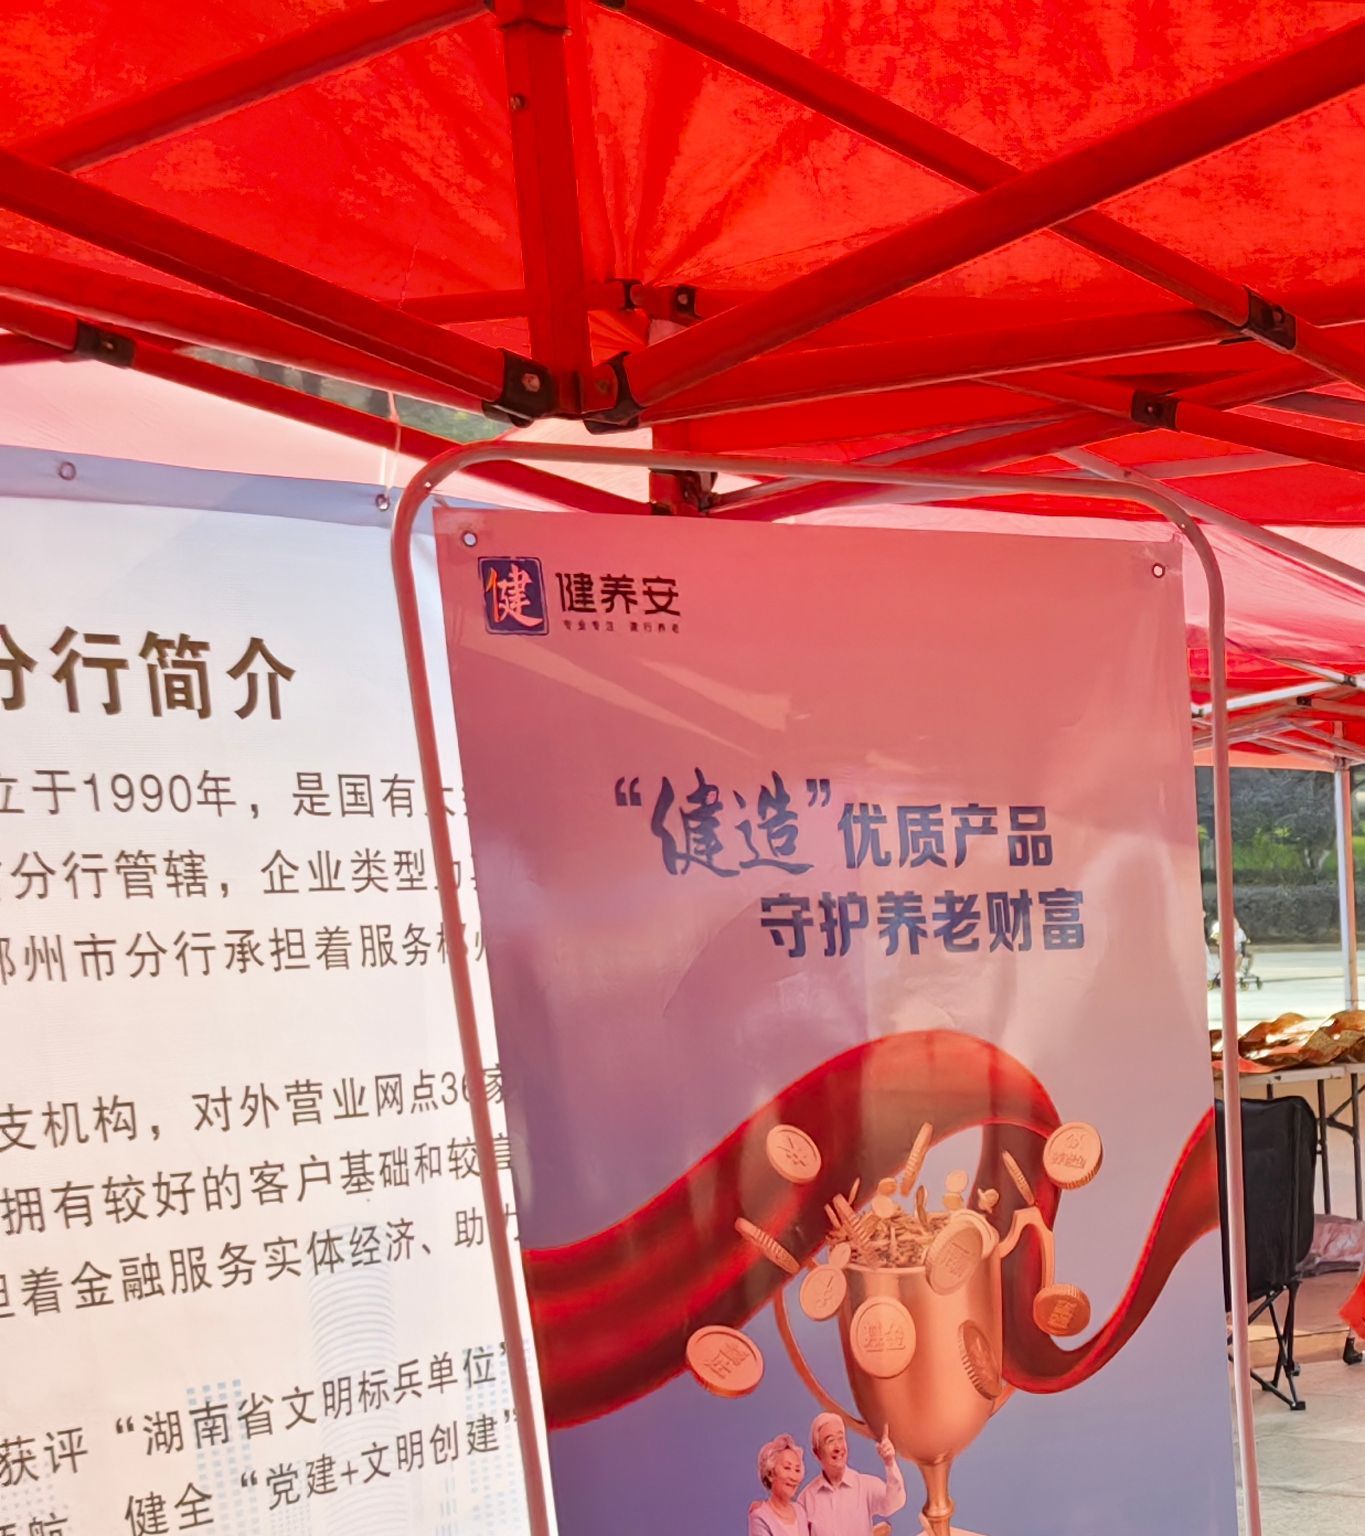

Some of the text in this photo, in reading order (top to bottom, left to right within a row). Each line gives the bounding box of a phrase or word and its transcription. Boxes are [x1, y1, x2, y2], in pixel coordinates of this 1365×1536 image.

[486, 562, 682, 629] 健 健养安
[0, 622, 297, 721] 分行简介
[760, 887, 1085, 959] 守护养老财富
